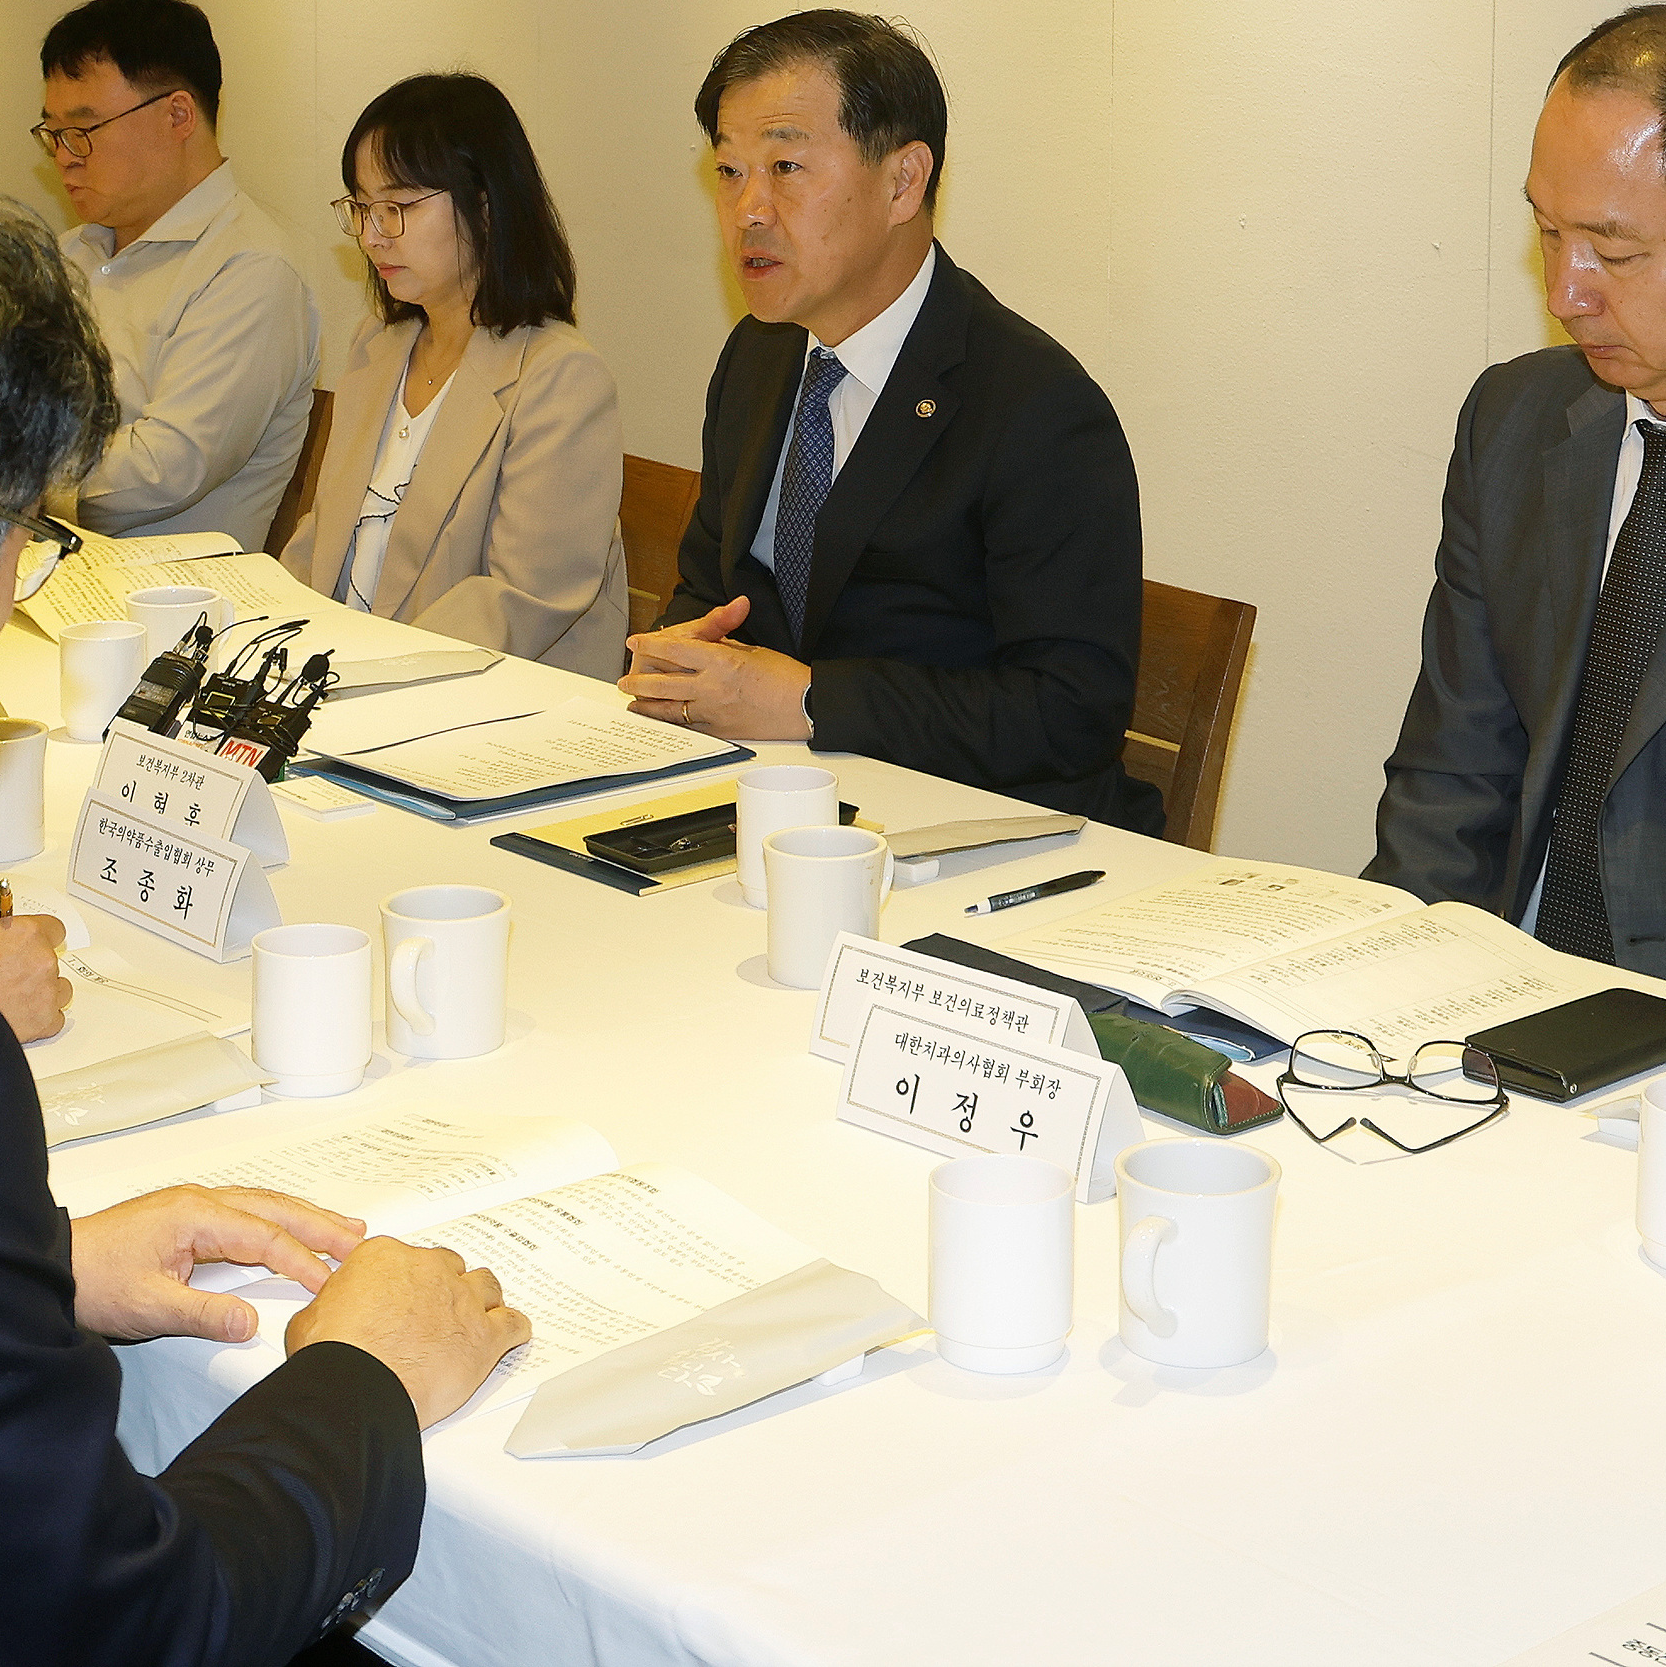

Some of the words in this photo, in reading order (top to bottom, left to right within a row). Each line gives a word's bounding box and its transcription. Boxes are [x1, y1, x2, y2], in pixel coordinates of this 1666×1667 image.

[136, 754, 179, 781] 보건복지부
[180, 769, 205, 791] 2차관
[219, 739, 265, 768] MTN
[121, 780, 137, 803] 이
[99, 817, 193, 870] 한국의약품수출입협회
[194, 856, 215, 878] 상무
[99, 856, 118, 885] 조
[137, 869, 155, 903] 종
[173, 885, 194, 921] 화
[856, 969, 925, 1003] 보건복지부
[929, 990, 1030, 1034] 보건의료정책관
[895, 1032, 1011, 1084] 대한치과의사협회
[1015, 1068, 1062, 1100] 부회장
[895, 1073, 920, 1115] 이
[952, 1092, 979, 1133] 정
[1009, 1110, 1039, 1150] 우
